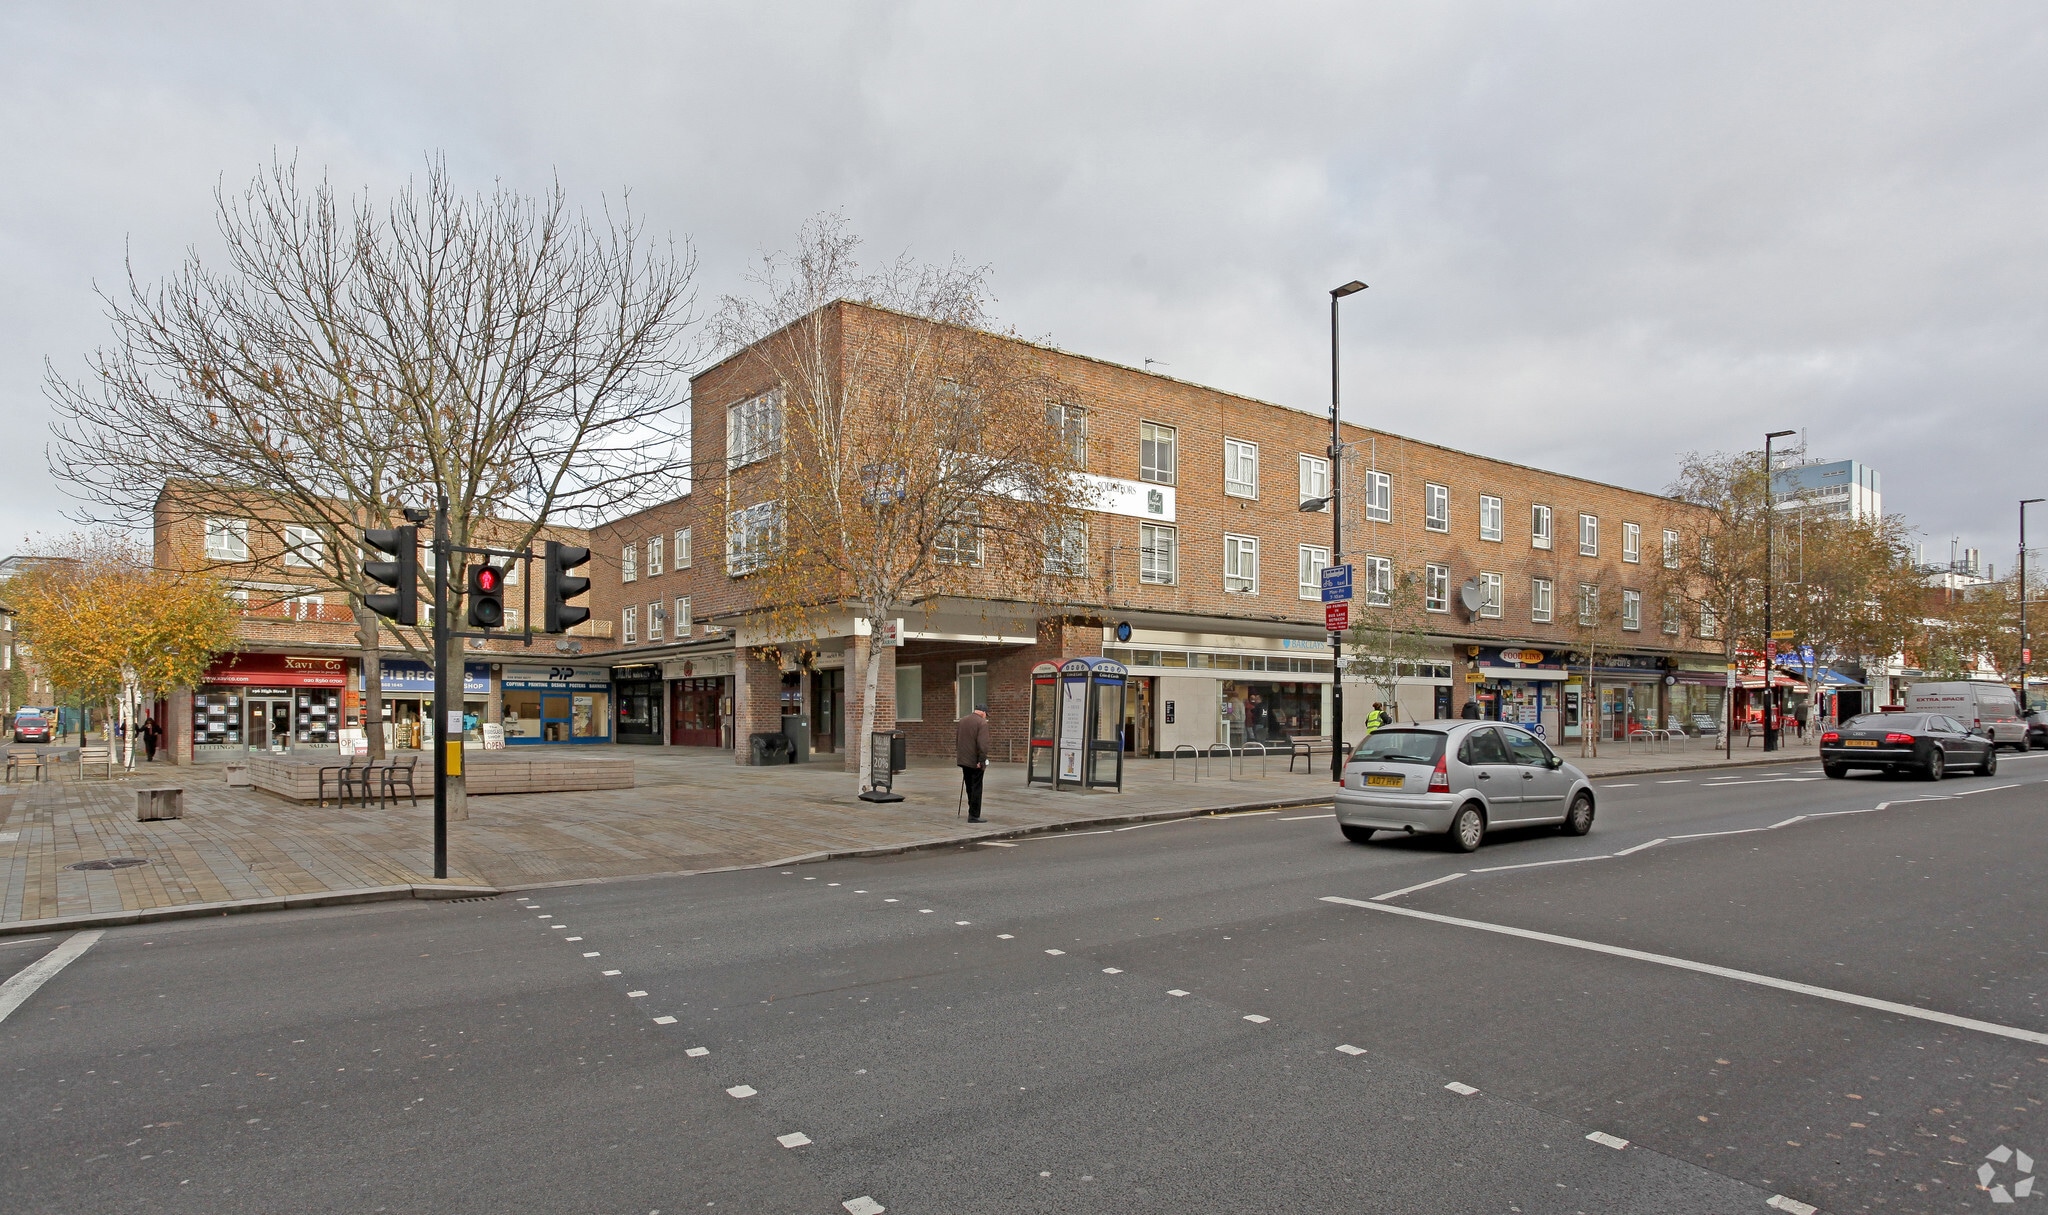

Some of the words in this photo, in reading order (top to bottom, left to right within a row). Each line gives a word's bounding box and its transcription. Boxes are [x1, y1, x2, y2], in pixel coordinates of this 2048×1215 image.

[1097, 481, 1136, 495] SOLICITORS
[1291, 640, 1324, 649] BARCLAYS
[284, 660, 312, 668] Xavi
[325, 661, 341, 670] Co
[874, 757, 888, 768] 20%
